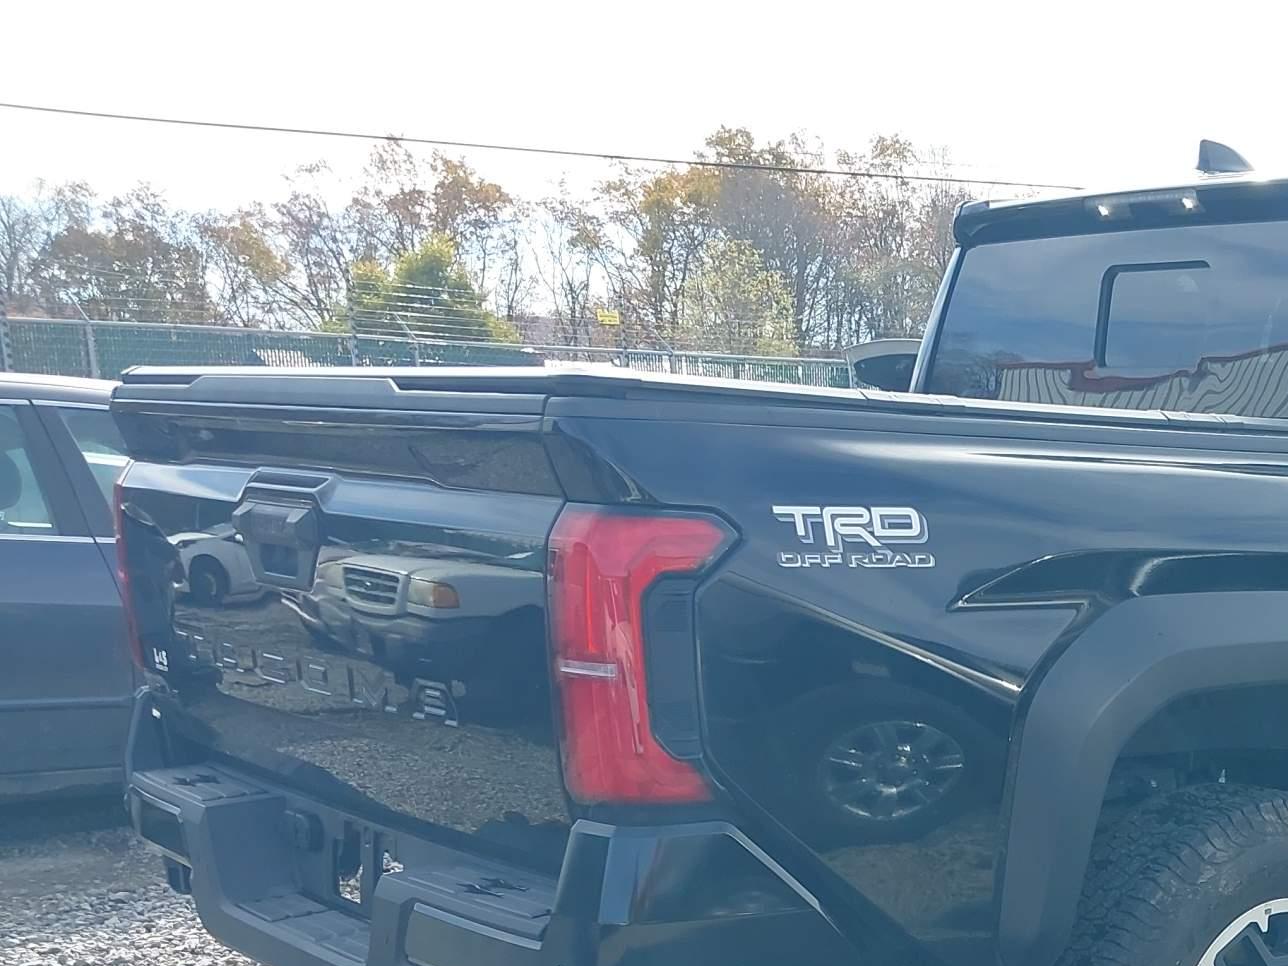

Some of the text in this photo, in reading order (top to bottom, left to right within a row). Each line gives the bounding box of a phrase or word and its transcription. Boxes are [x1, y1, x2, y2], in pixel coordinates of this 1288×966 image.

[772, 505, 928, 553] TRD
[777, 551, 936, 568] OFF ROAD
